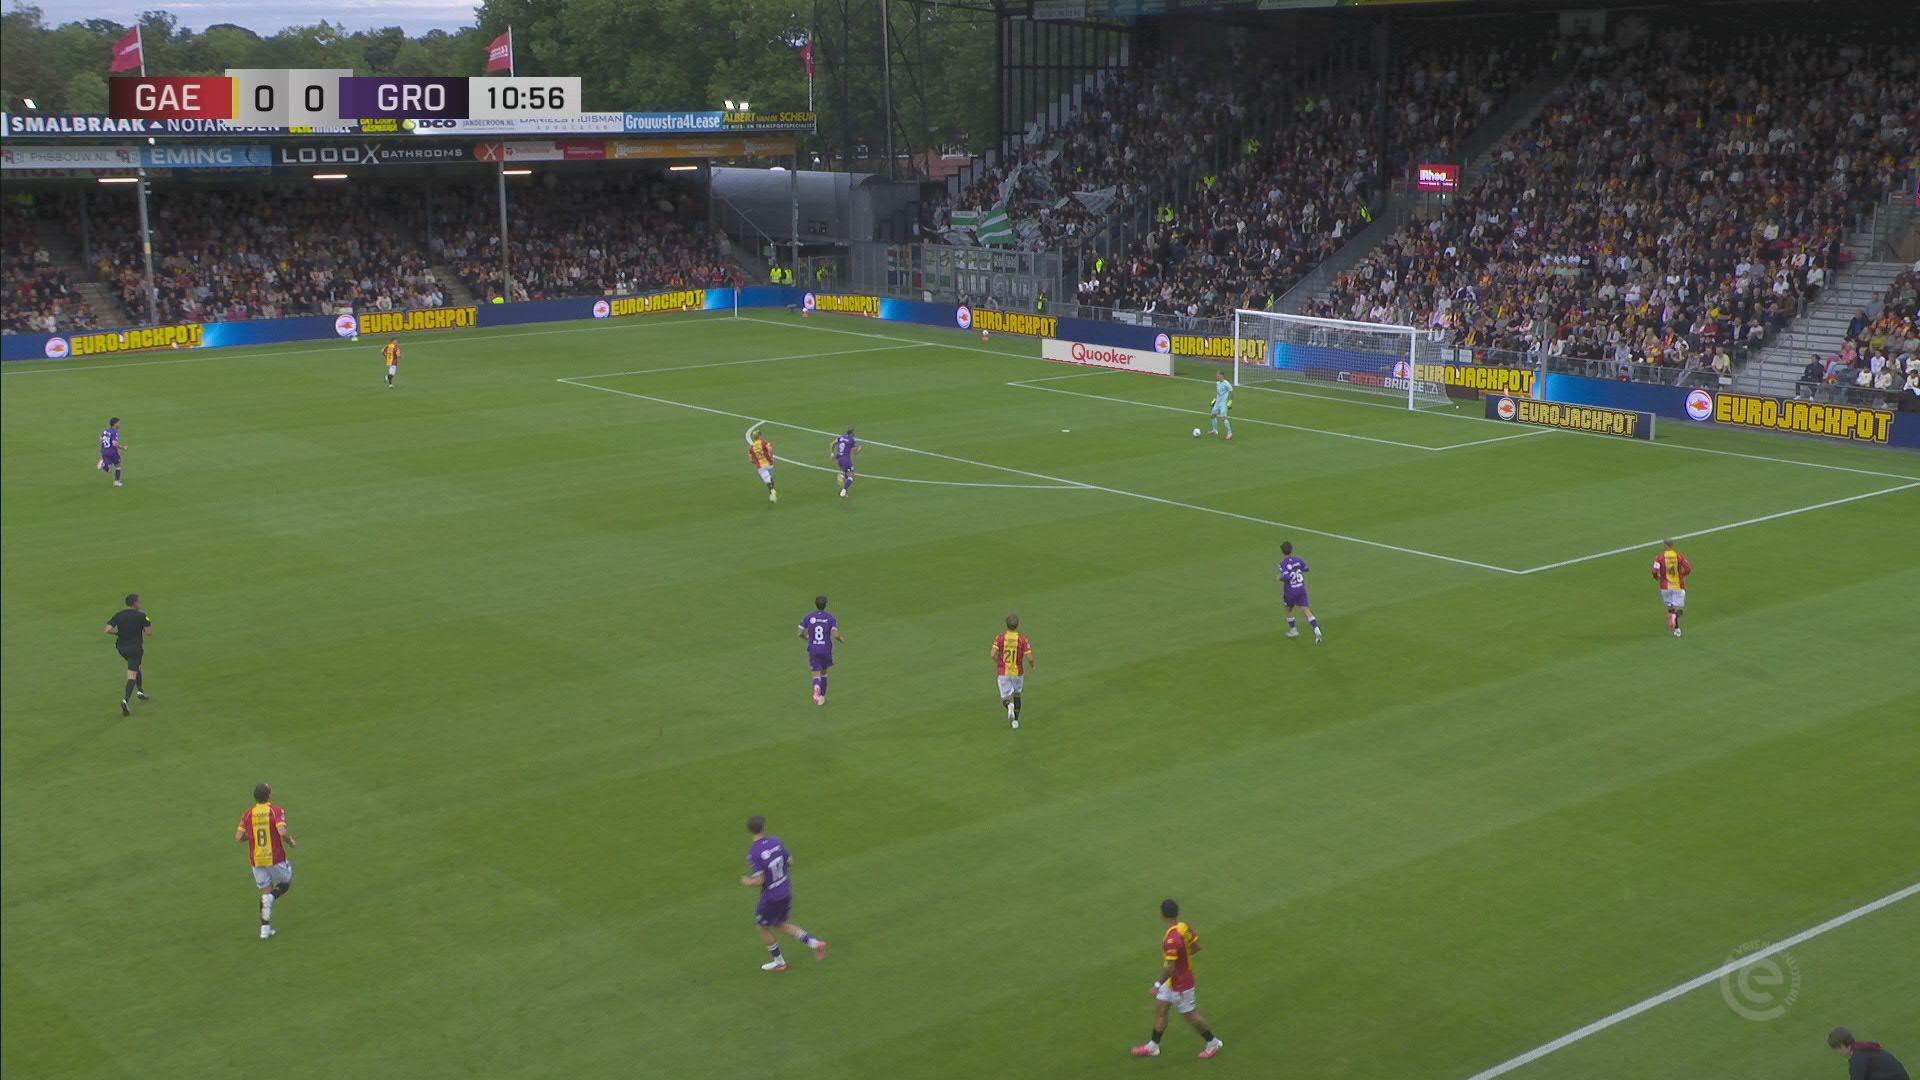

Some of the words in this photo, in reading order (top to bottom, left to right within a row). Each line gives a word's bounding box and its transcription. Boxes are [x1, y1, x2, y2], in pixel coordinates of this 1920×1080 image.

[11, 116, 146, 132] SMALBRAAK
[418, 119, 457, 128] DCO
[625, 114, 720, 129] Grouwstra4Lease
[724, 112, 756, 122] ALBERT
[151, 147, 233, 165] EMING
[281, 143, 381, 165] LOOOX
[381, 148, 463, 159] BATHROOMS
[611, 289, 703, 316] EUROJACKPOT
[816, 294, 879, 313] EUROJACKPOT
[360, 306, 477, 334] EUROJACKPOT
[973, 309, 1057, 338] EUROJACKPOT
[71, 323, 199, 356] EUROJACKPOT
[1071, 342, 1134, 365] Quooker
[1414, 364, 1532, 392] EUROJACKPOT
[1519, 400, 1636, 436] EUROJACKPOT
[1716, 395, 1892, 441] EUROJACKPOT
[1290, 569, 1304, 585] 26
[814, 625, 824, 641] 8
[1004, 649, 1016, 664] 21
[256, 828, 267, 848] 8
